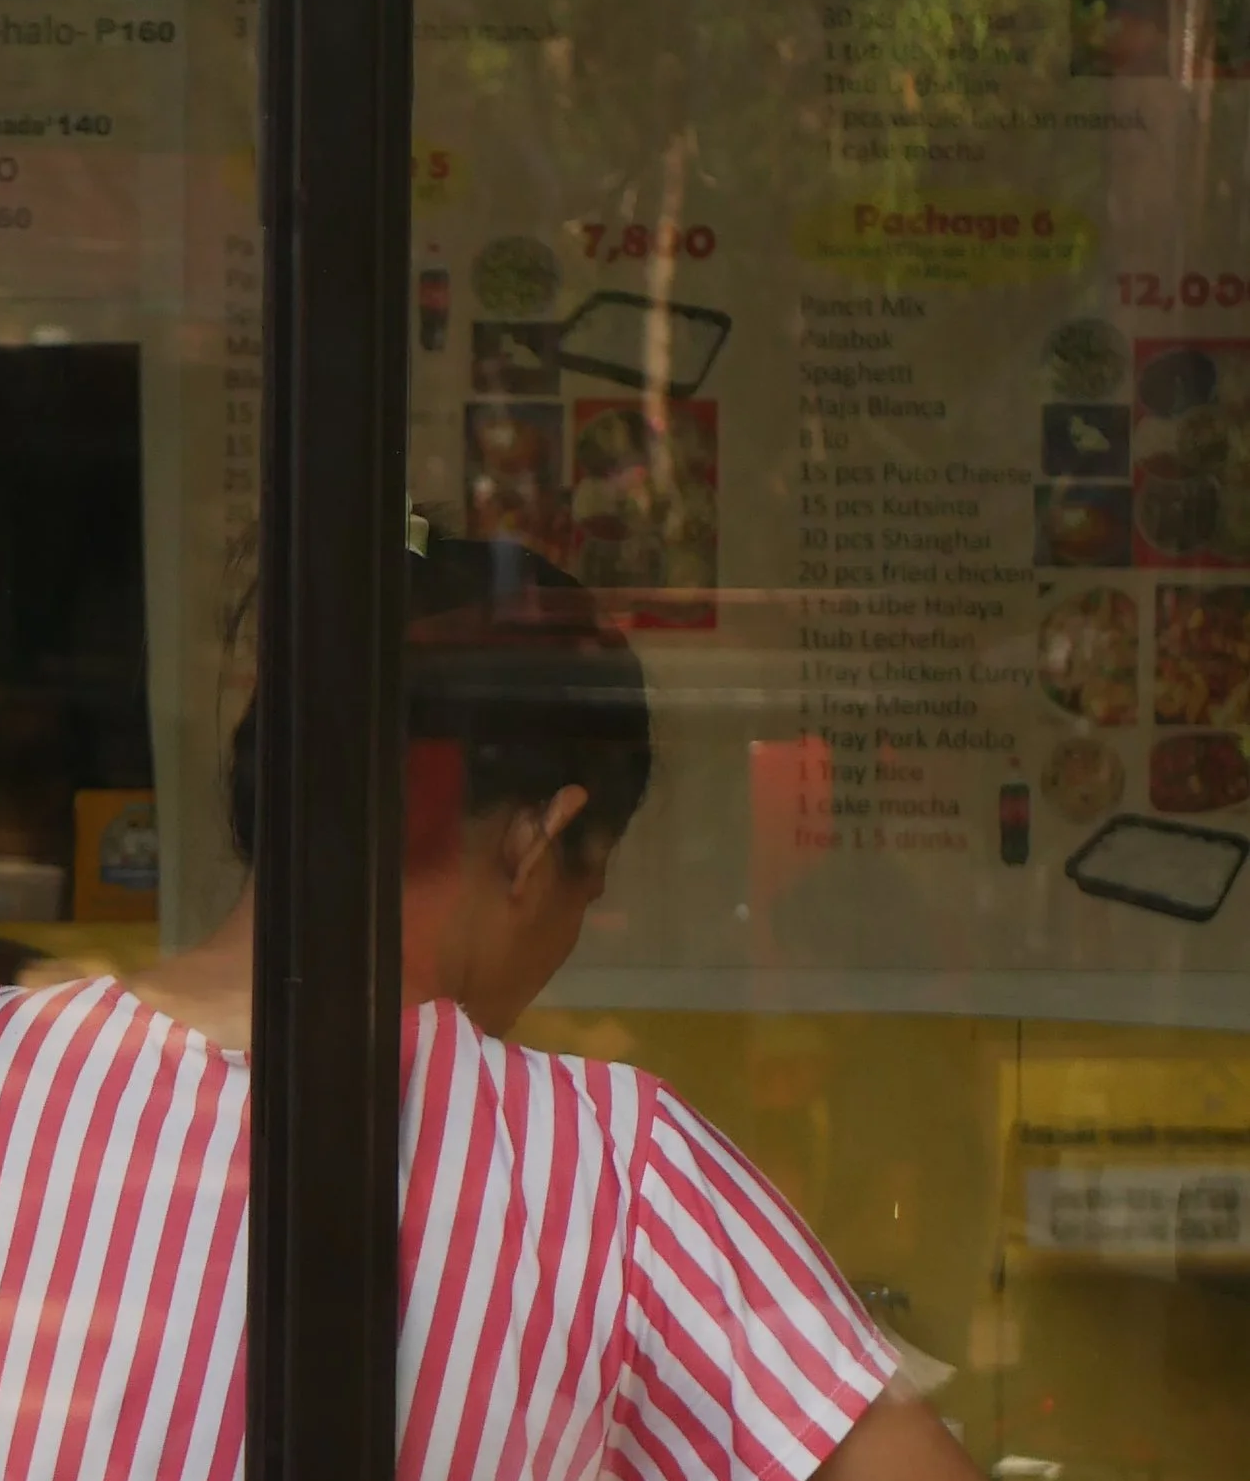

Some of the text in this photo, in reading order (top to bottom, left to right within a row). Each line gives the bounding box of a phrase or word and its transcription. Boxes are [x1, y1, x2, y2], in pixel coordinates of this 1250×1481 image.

[1031, 209, 1056, 236] 6
[881, 293, 927, 317] Mix
[799, 361, 914, 387] Spaghetti
[867, 394, 948, 420] Blanca
[834, 499, 875, 522] pcs
[882, 496, 980, 518] Kutsinta
[835, 532, 875, 553] pcs
[881, 528, 992, 556] Shanghai
[835, 565, 875, 588] pcs
[881, 562, 937, 585] fried
[944, 561, 1035, 586] chicken
[868, 660, 1035, 689] Chicken Curry
[875, 694, 978, 718] Menudo
[875, 728, 928, 751] Pork
[935, 727, 1016, 750] Adobo
[817, 794, 961, 817] cake mocha
